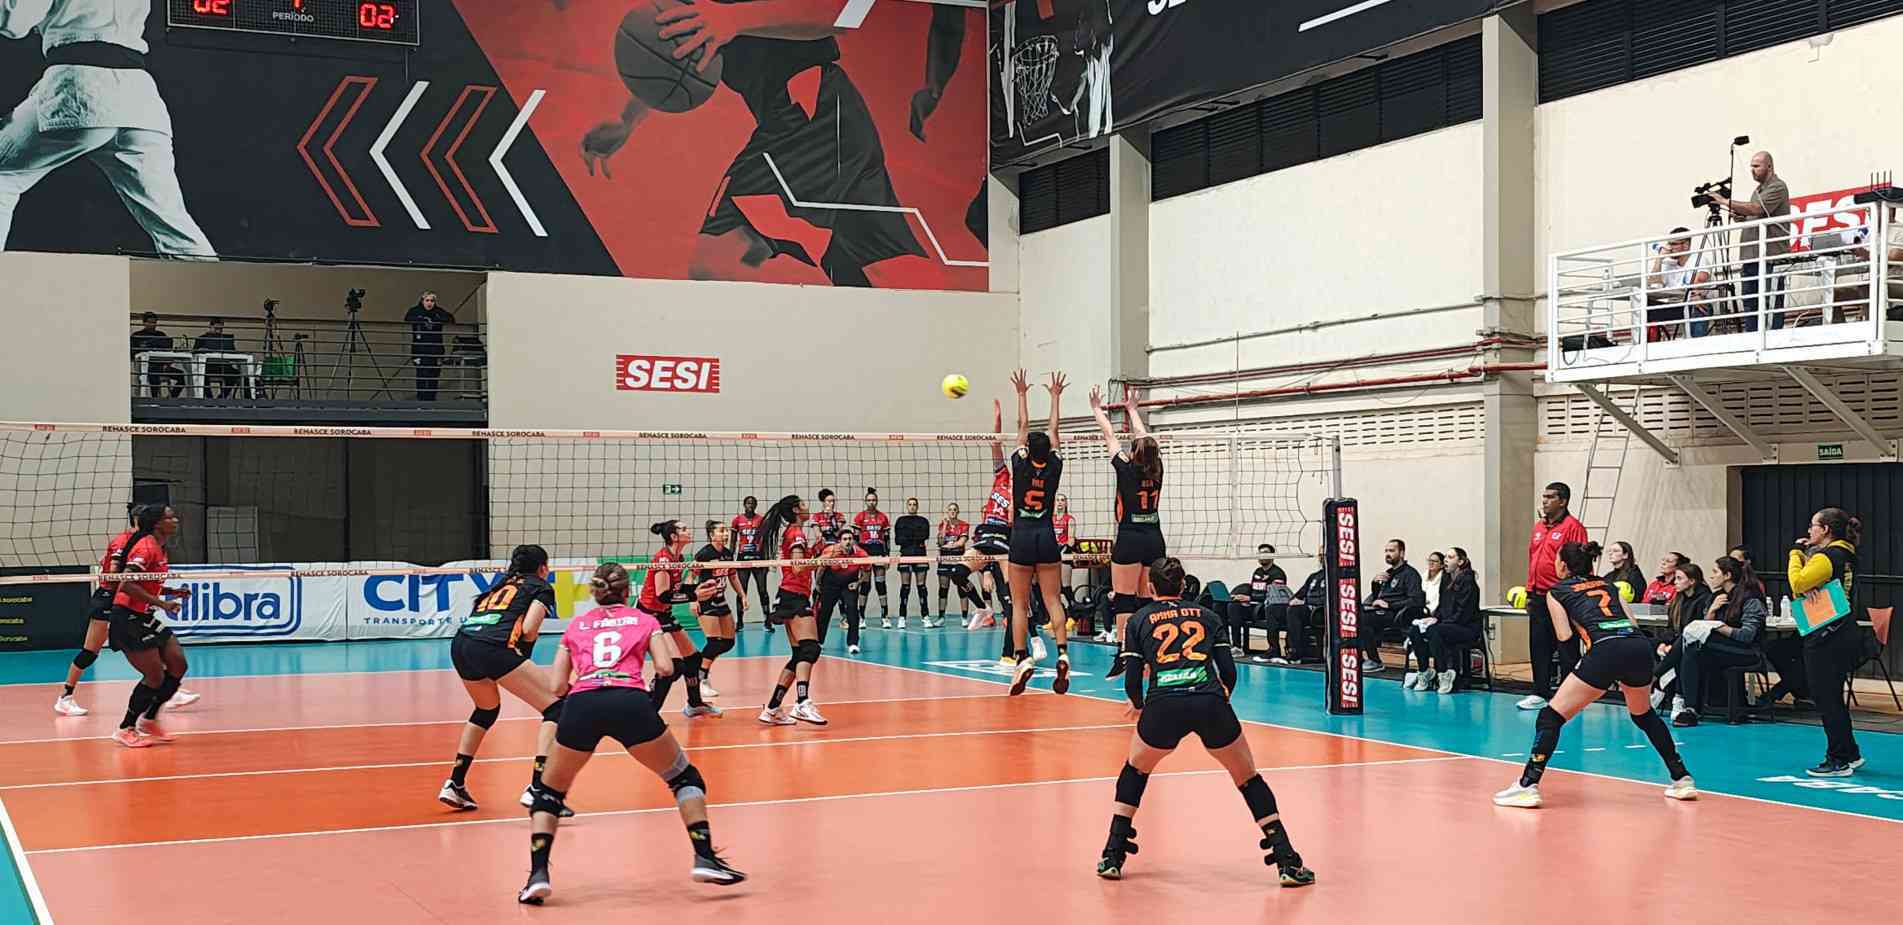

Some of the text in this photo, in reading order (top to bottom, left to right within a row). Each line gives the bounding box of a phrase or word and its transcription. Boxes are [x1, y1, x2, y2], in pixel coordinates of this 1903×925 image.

[359, 3, 395, 28] 02
[624, 359, 711, 390] SESI
[1338, 512, 1355, 563] SESI
[475, 585, 518, 613] 10
[1180, 607, 1201, 618] OTT
[1340, 583, 1357, 635] SESI
[1586, 589, 1613, 617] 7
[364, 615, 452, 625] TRANSPORTE
[593, 631, 622, 668] 6
[1152, 620, 1208, 664] 22
[1341, 653, 1358, 705] SESI
